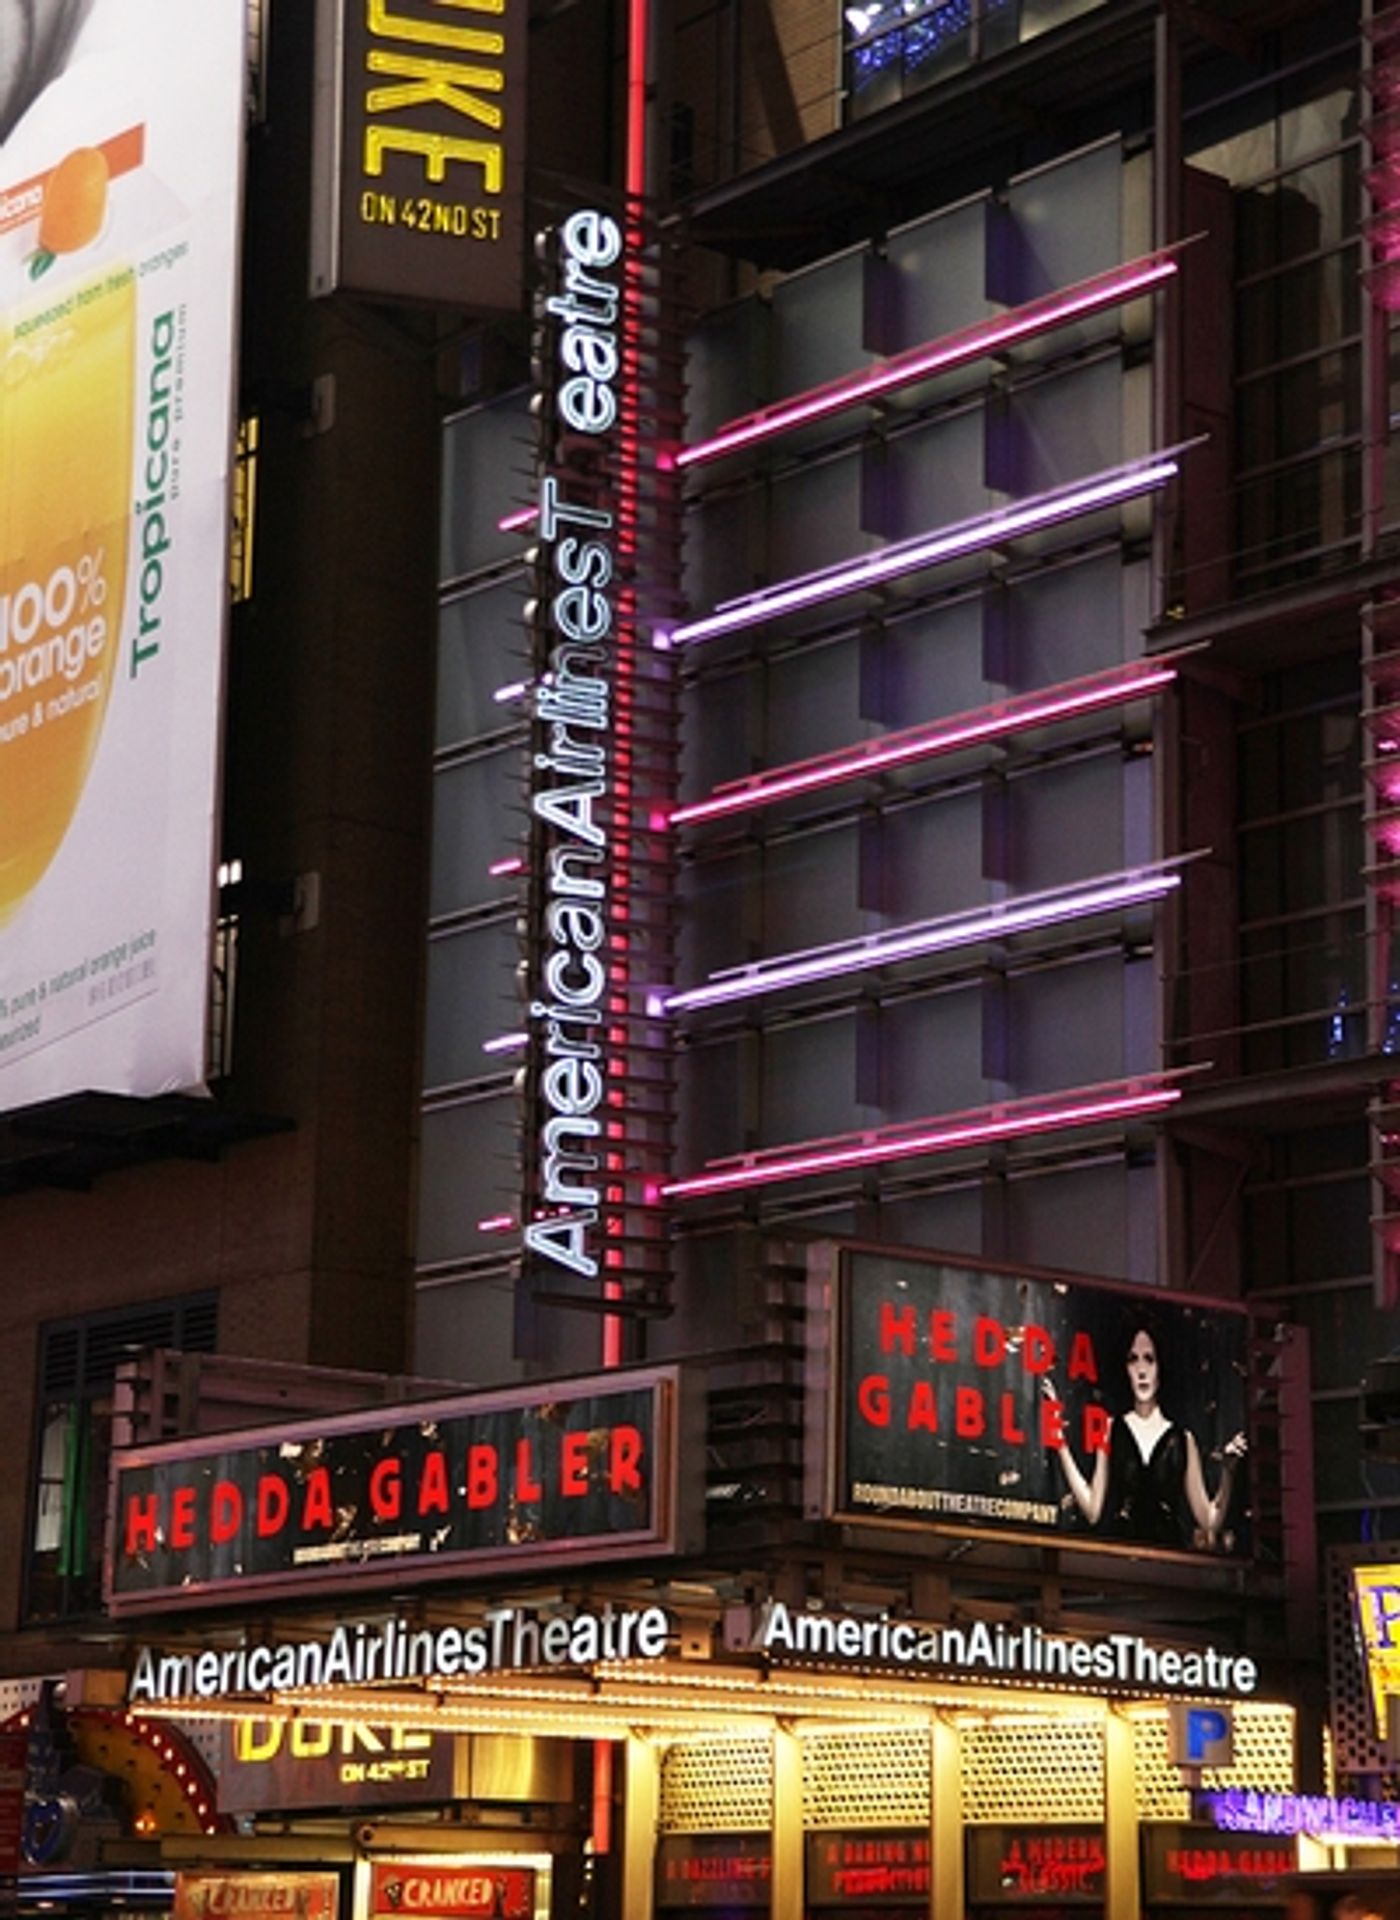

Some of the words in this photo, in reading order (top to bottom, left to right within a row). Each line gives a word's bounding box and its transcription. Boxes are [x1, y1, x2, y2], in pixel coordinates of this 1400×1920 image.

[361, 191, 395, 225] ON
[400, 198, 467, 237] 42ND
[472, 206, 501, 240] ST
[131, 310, 175, 678] Tropicana
[879, 1302, 1098, 1383] HEDDA
[858, 1374, 1112, 1456] GABLER
[126, 1466, 333, 1555] HEDDA
[369, 1425, 643, 1519] GABLER
[1187, 1710, 1226, 1759] P
